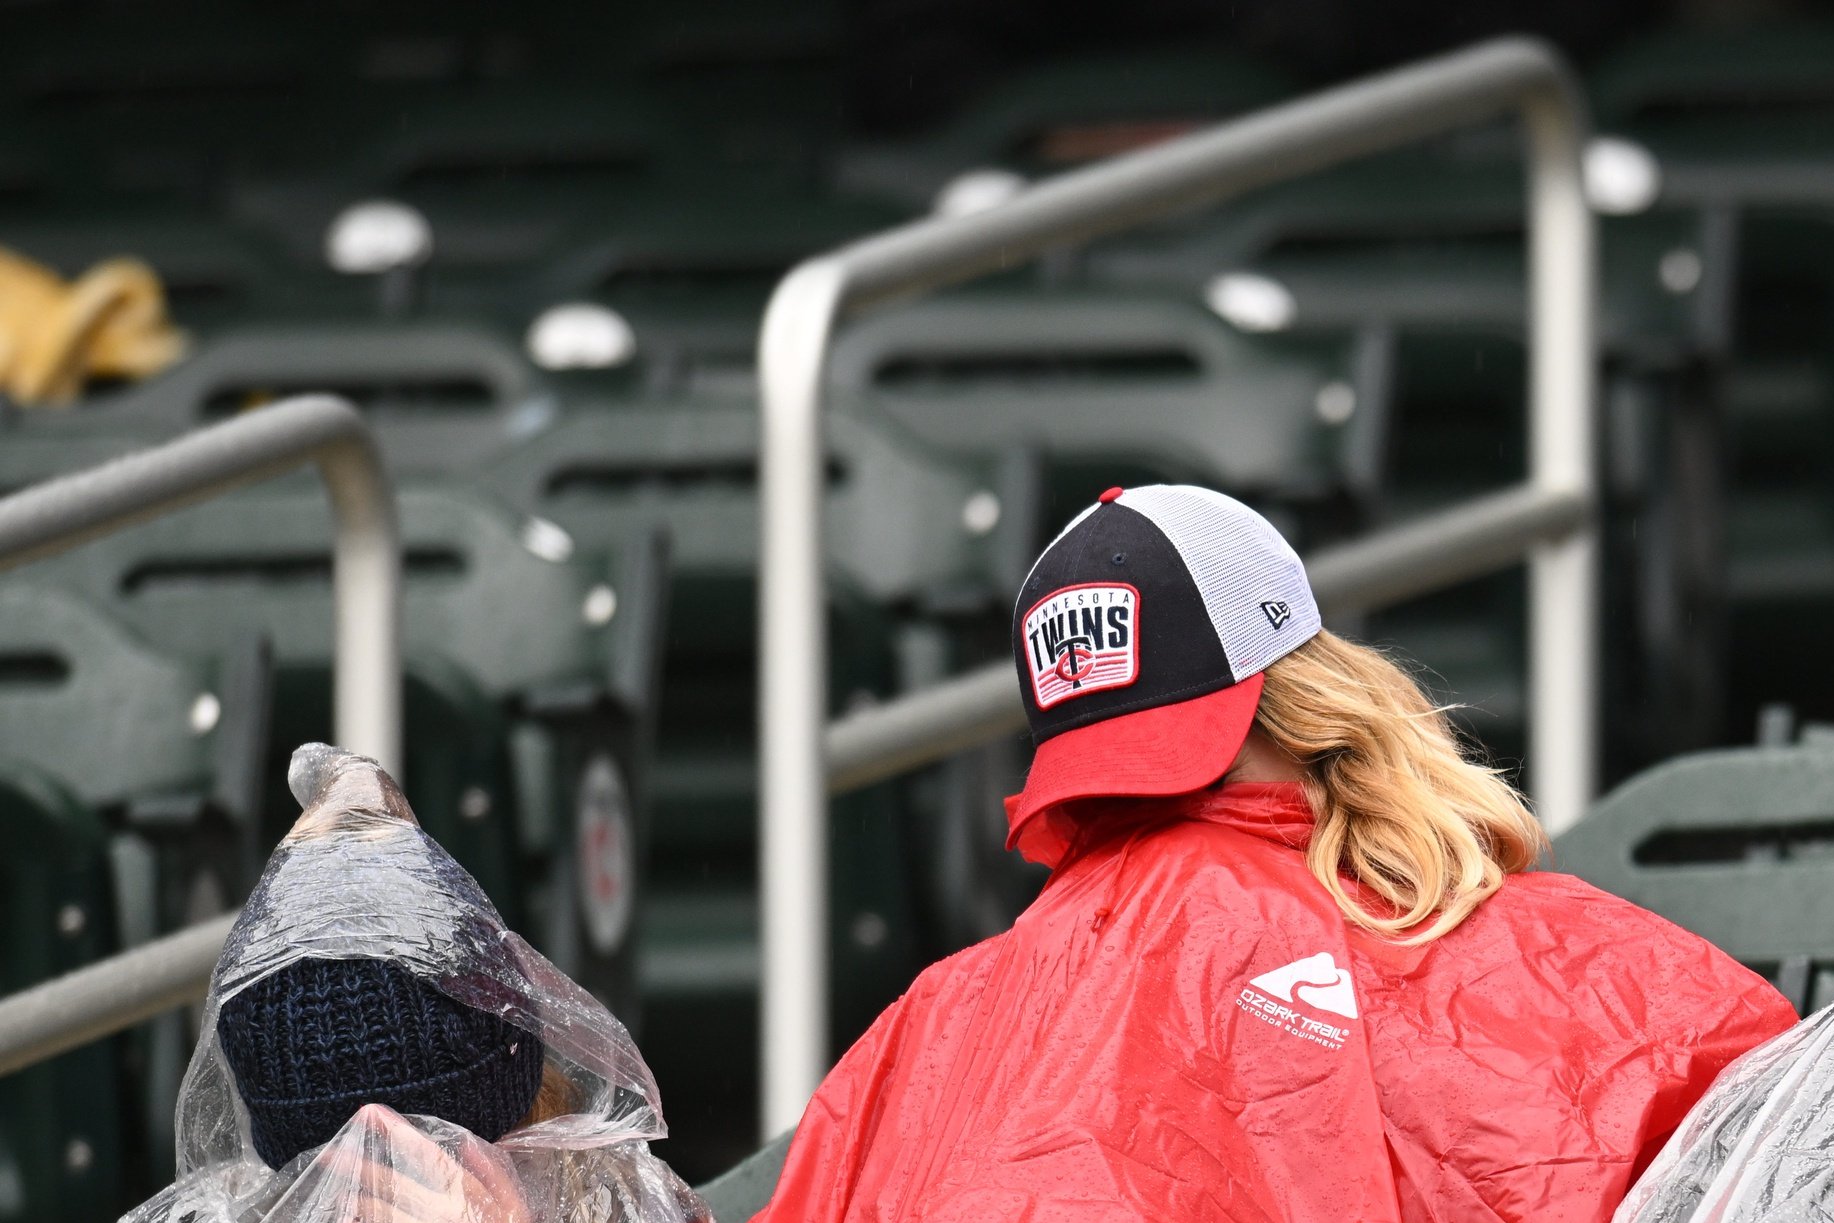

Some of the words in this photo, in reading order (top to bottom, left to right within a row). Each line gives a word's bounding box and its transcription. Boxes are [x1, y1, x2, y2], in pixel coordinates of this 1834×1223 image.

[1027, 592, 1130, 629] MINNESOTA
[1029, 605, 1129, 673] TWINS
[1235, 998, 1282, 1028] OUTDOOR
[1284, 1023, 1342, 1051] EQUIPMENT
[1240, 989, 1301, 1024] OZARK
